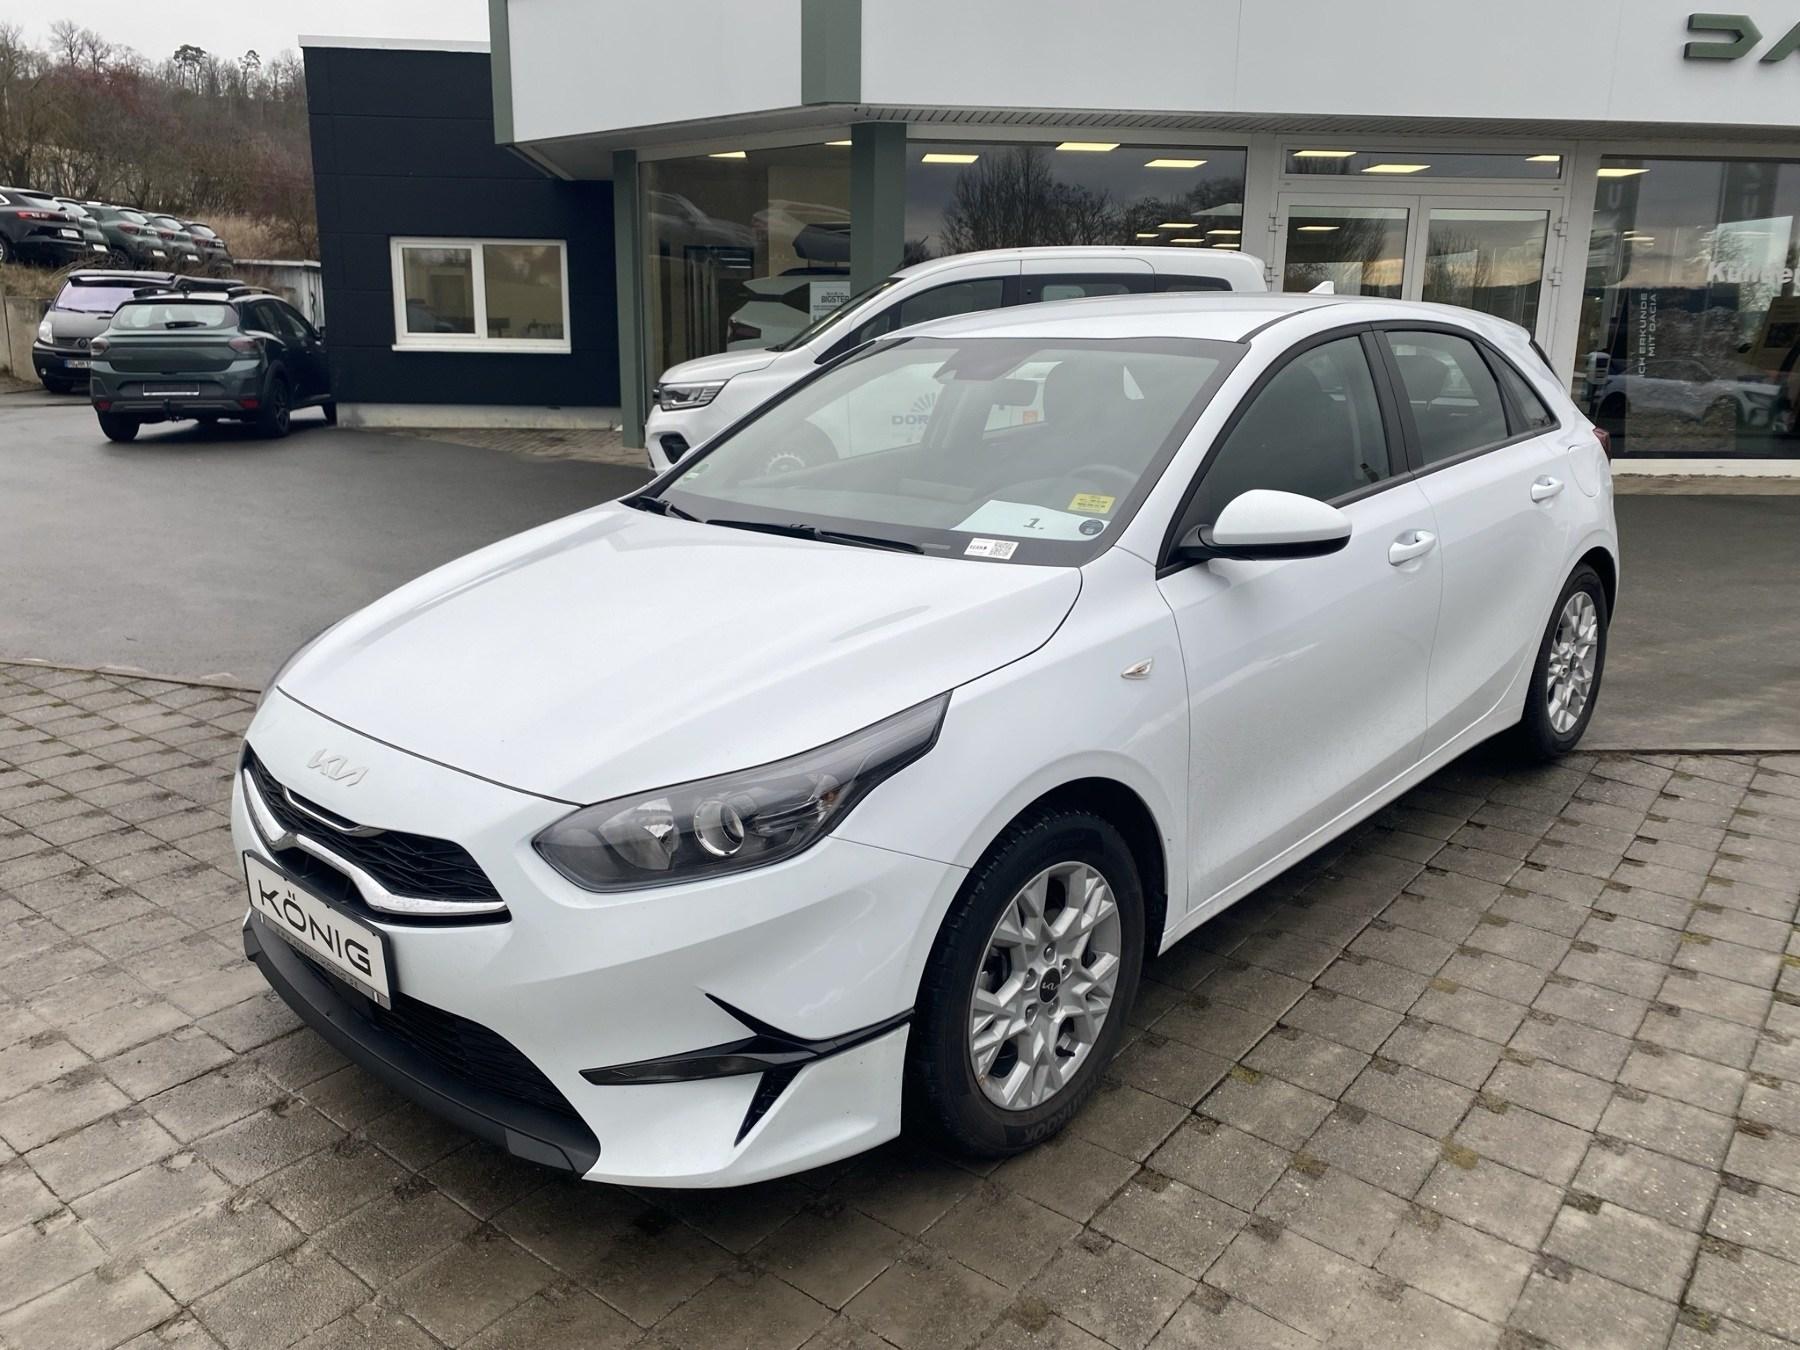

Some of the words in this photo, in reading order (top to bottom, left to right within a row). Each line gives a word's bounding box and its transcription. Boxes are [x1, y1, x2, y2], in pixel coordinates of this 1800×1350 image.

[1640, 293, 1648, 354] ERKUNDE
[1649, 293, 1657, 332] DACIA
[1648, 334, 1656, 357] MIT
[307, 748, 369, 786] KIA
[258, 879, 373, 977] KÖNIG
